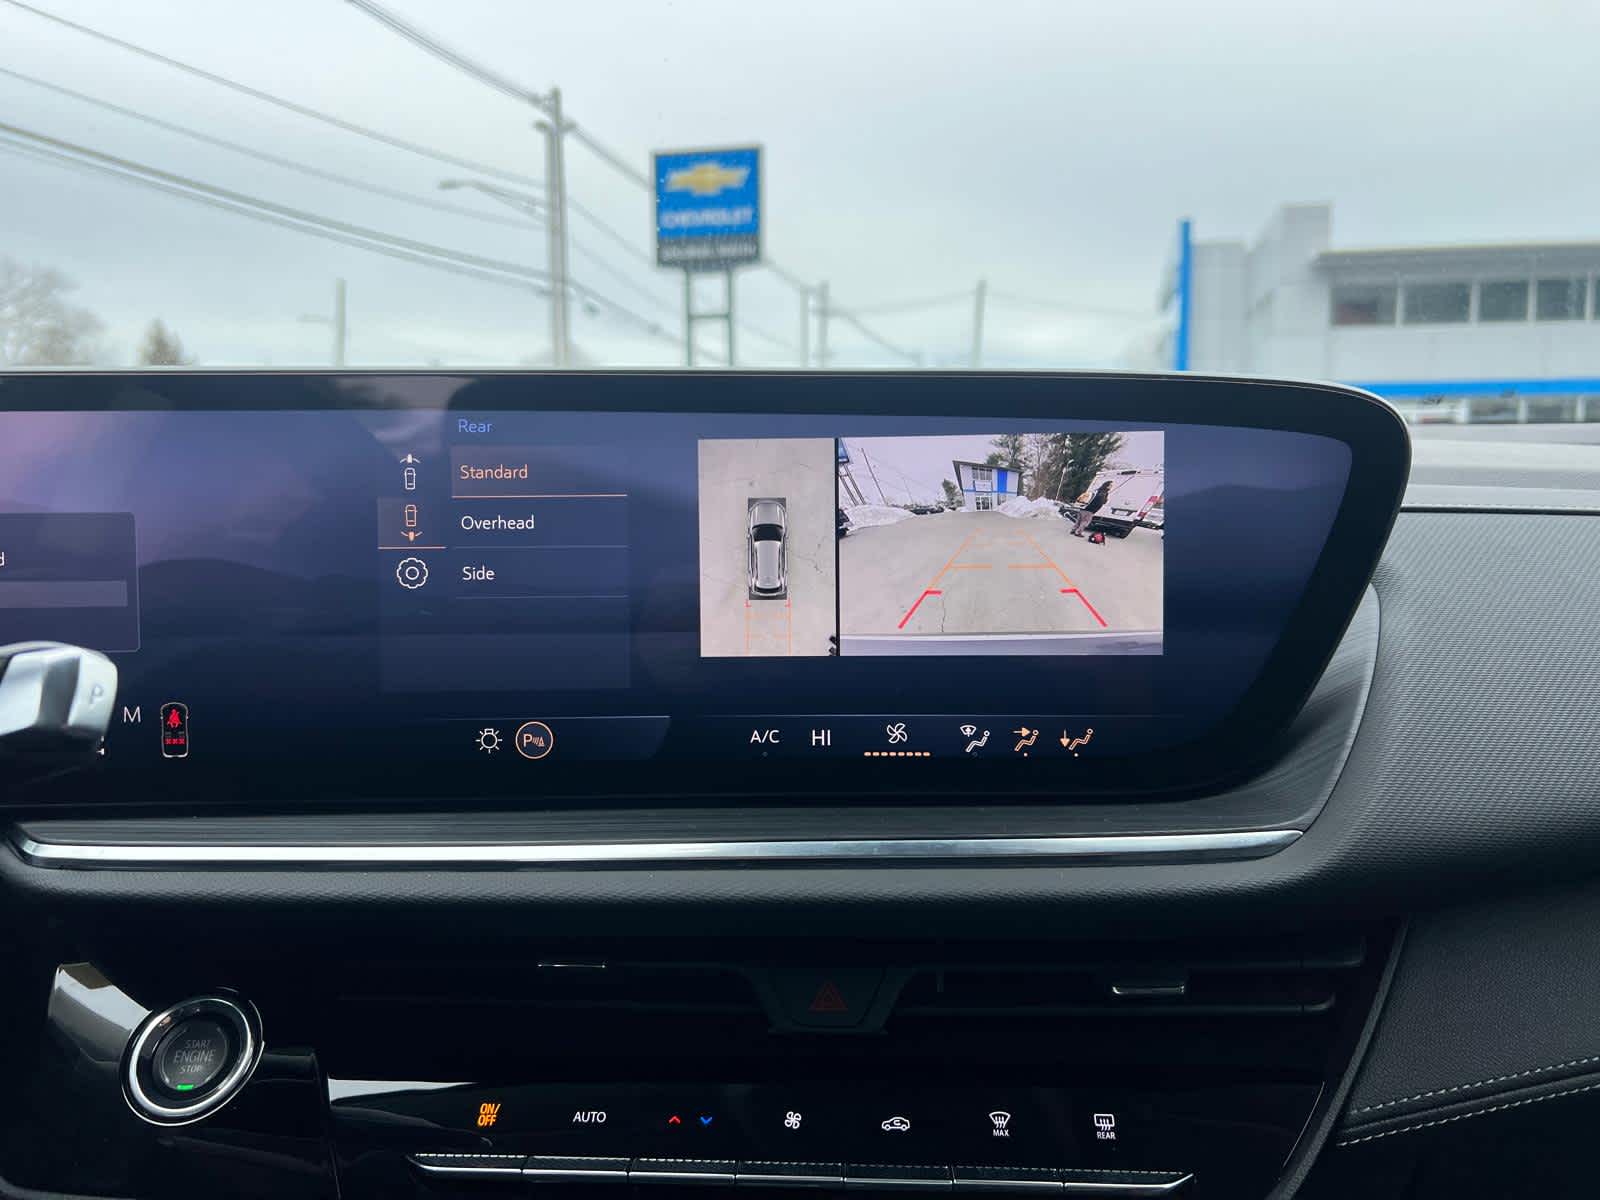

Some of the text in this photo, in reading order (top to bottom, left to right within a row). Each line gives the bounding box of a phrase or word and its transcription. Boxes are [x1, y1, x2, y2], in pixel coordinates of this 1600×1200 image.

[458, 419, 493, 433] Rear
[460, 464, 529, 480] Standard
[460, 514, 535, 531] Overhead
[462, 565, 496, 581] Side
[123, 706, 141, 723] M
[750, 729, 780, 744] A/C
[811, 729, 831, 746] HI
[184, 1039, 212, 1049] START
[174, 1049, 216, 1062] ENGINE
[180, 1064, 204, 1073] STOP
[479, 1103, 501, 1114] ON/
[477, 1114, 497, 1127] OFF
[573, 1111, 607, 1123] AUTO
[992, 1129, 1010, 1137] MAX
[1096, 1131, 1117, 1140] REAR
